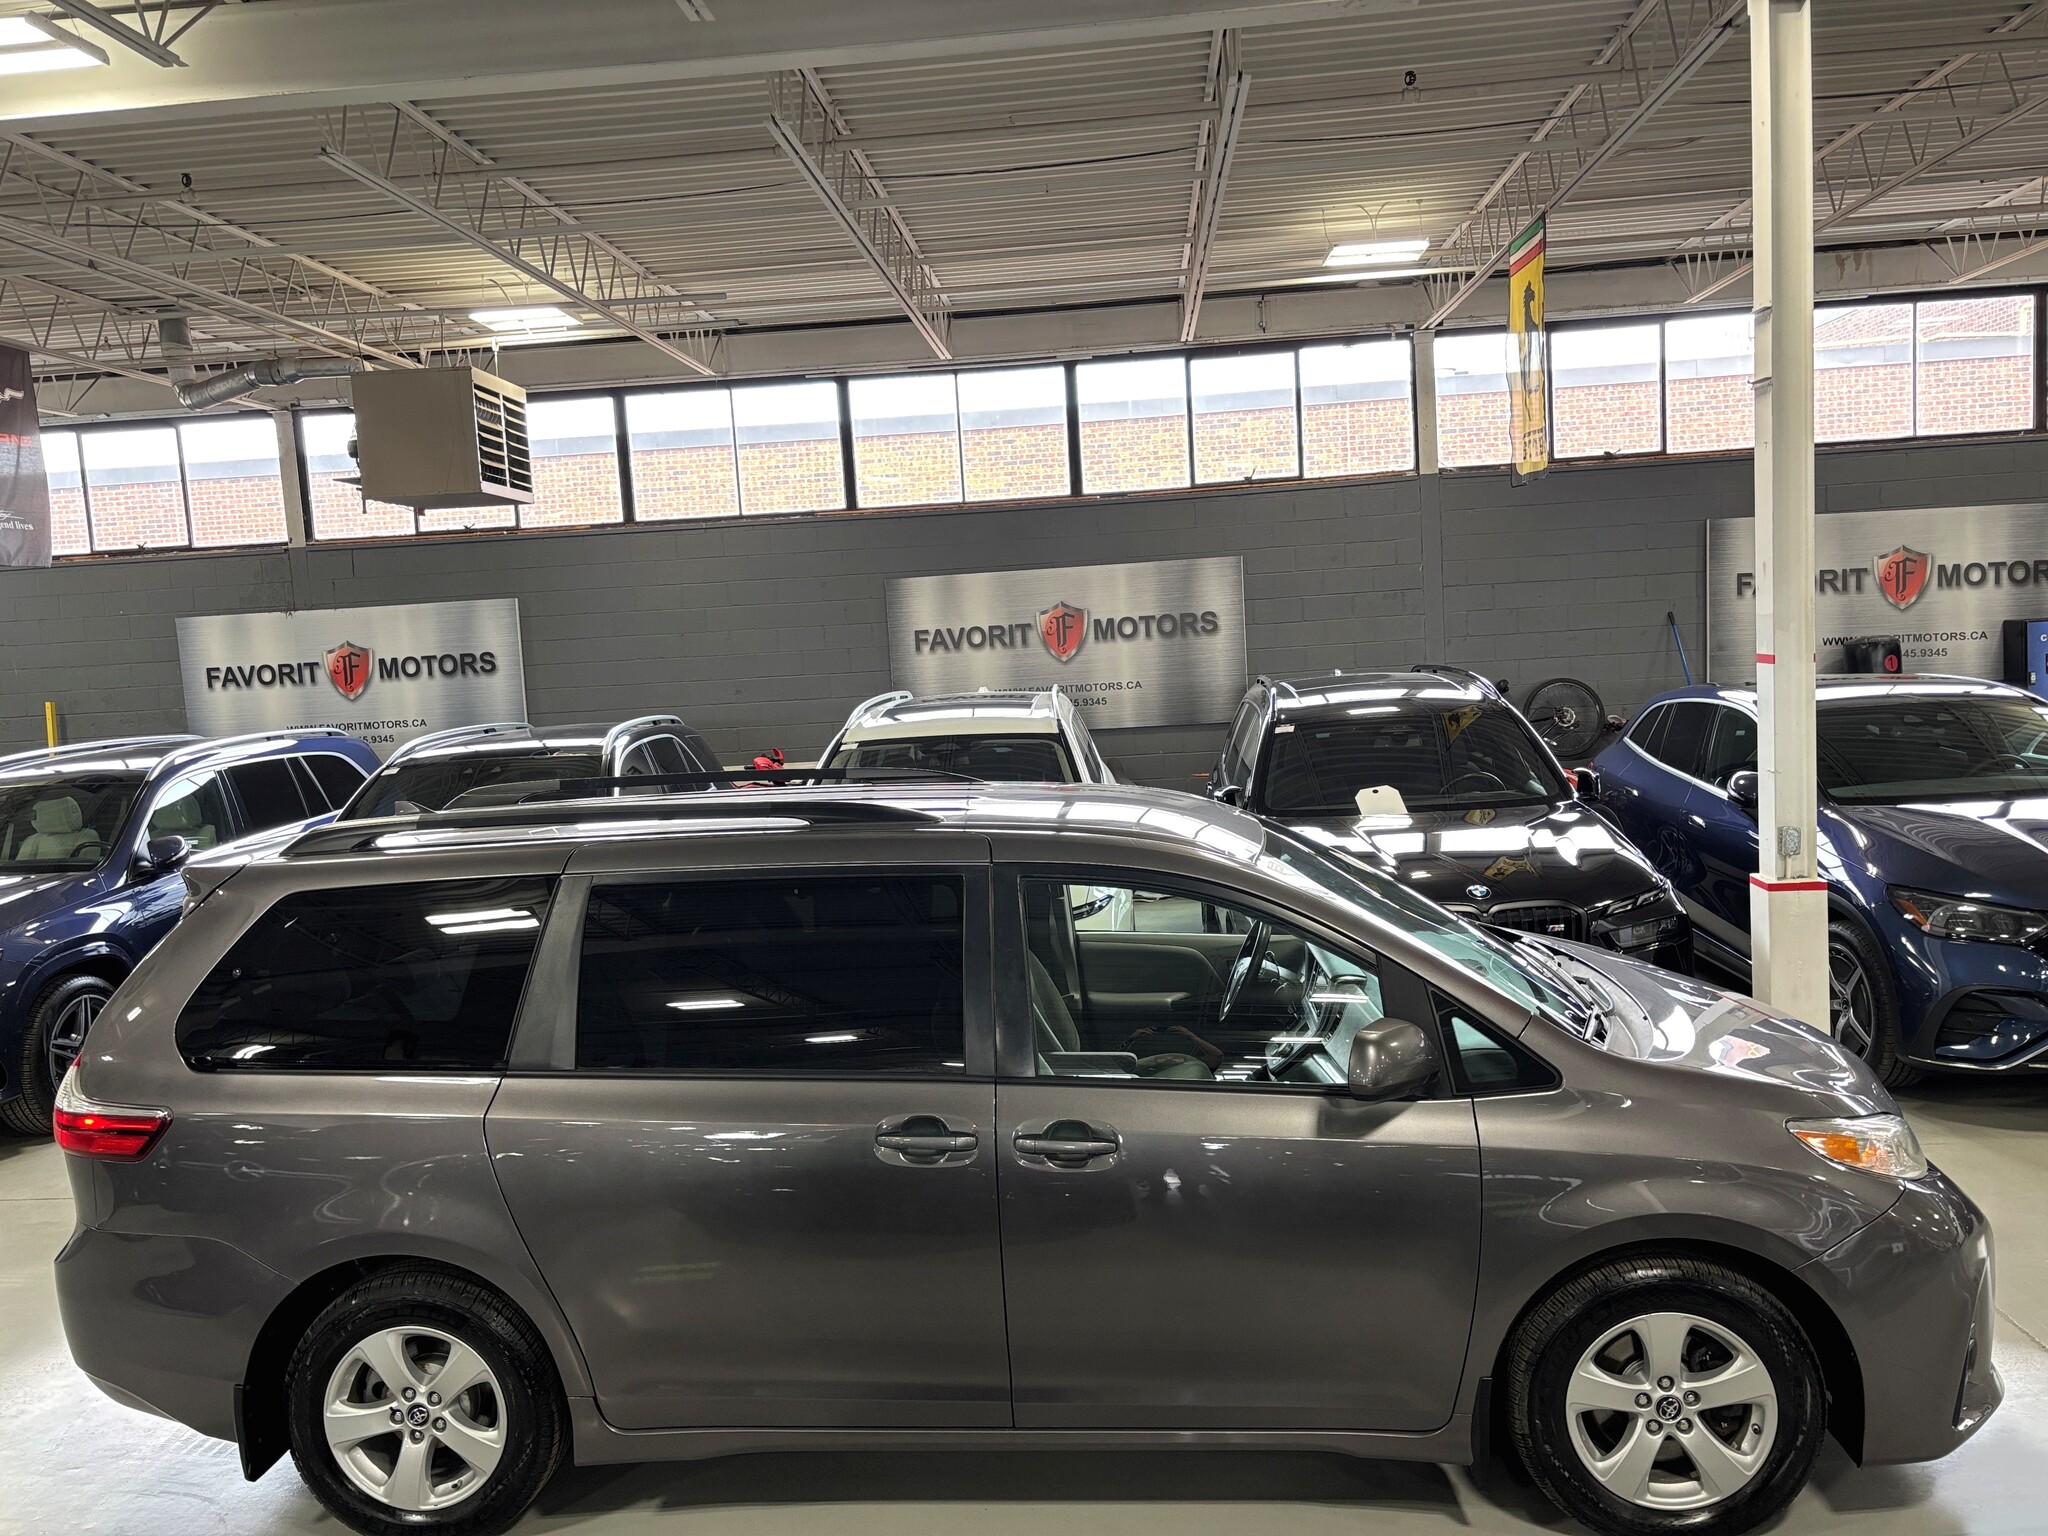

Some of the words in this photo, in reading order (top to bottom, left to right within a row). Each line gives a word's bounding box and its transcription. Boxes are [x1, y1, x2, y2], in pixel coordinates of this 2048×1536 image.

[14, 520, 34, 530] lives
[1736, 568, 1868, 596] FRIT
[914, 623, 1031, 652] FAVORIT
[1093, 611, 1219, 641] MOTORS
[1822, 631, 1988, 646] WWRITMOTORS.CA
[206, 661, 320, 688] FAVORIT
[378, 651, 497, 679] MOTORS
[286, 718, 428, 731] AVORITMOTORS.CA
[358, 734, 395, 744] 5.9345
